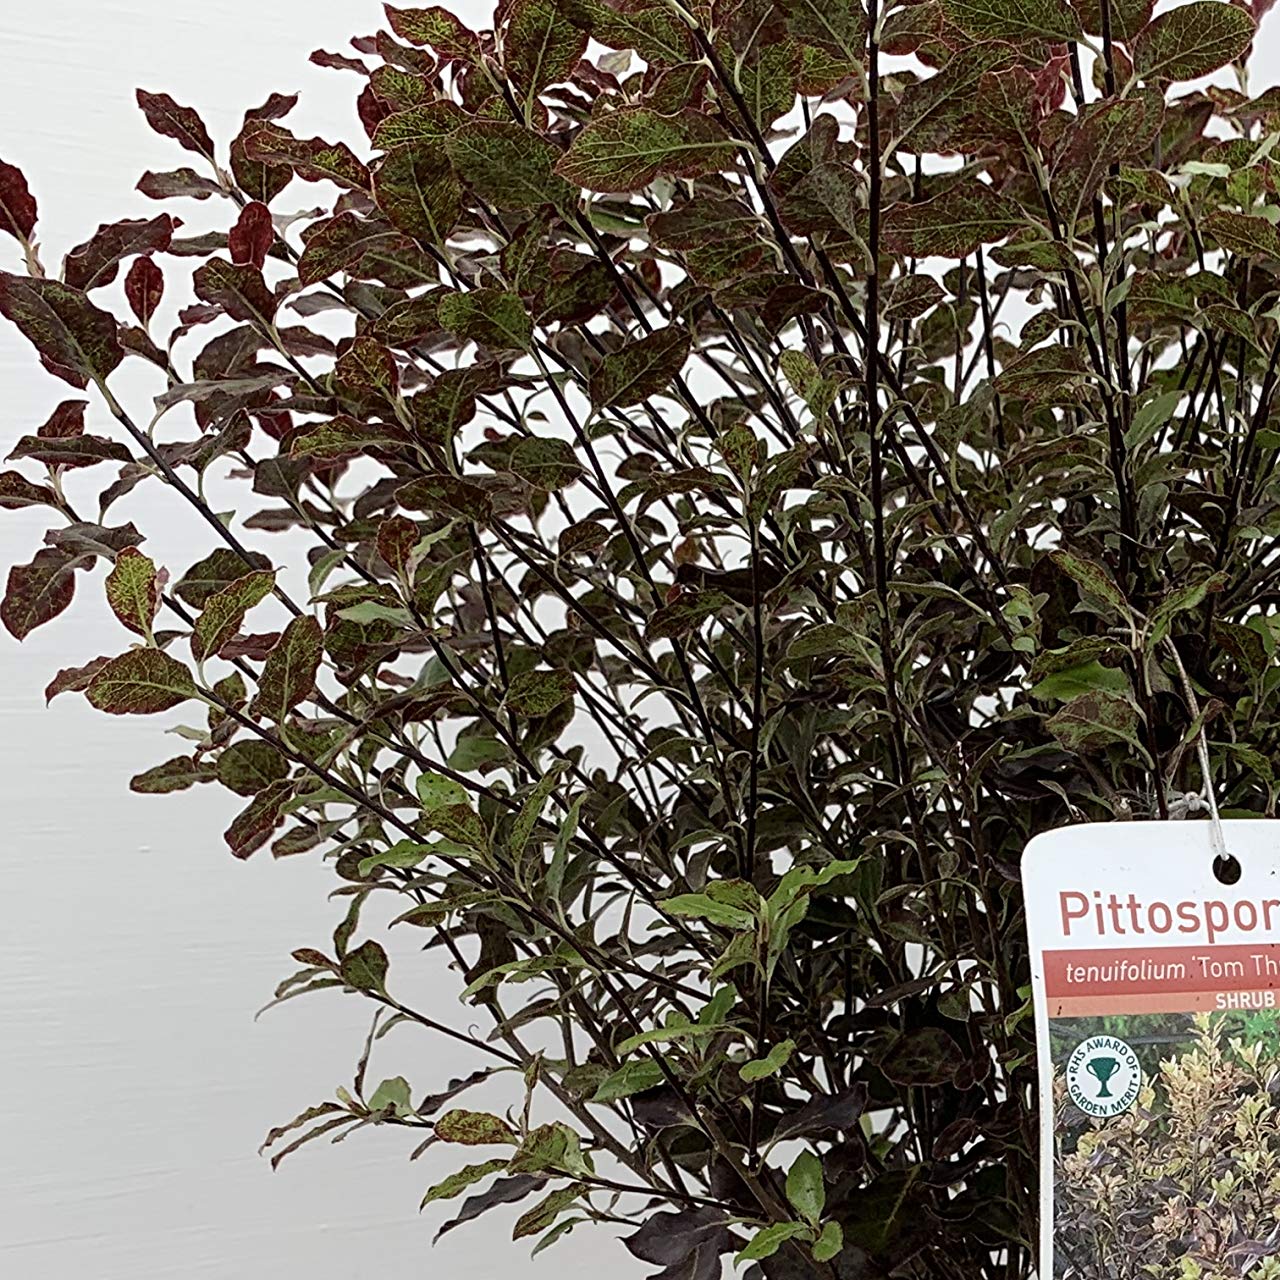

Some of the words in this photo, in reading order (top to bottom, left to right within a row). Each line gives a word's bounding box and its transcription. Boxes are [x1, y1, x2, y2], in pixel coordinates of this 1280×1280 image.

[1065, 959, 1186, 983] tenuifolium
[1215, 991, 1276, 1009] SHRUB
[1069, 1048, 1086, 1074] RHS
[1086, 1038, 1128, 1056] AWARD
[1126, 1055, 1139, 1071] OF
[1070, 1084, 1108, 1115] GARDEN
[1110, 1080, 1139, 1113] MERIT
